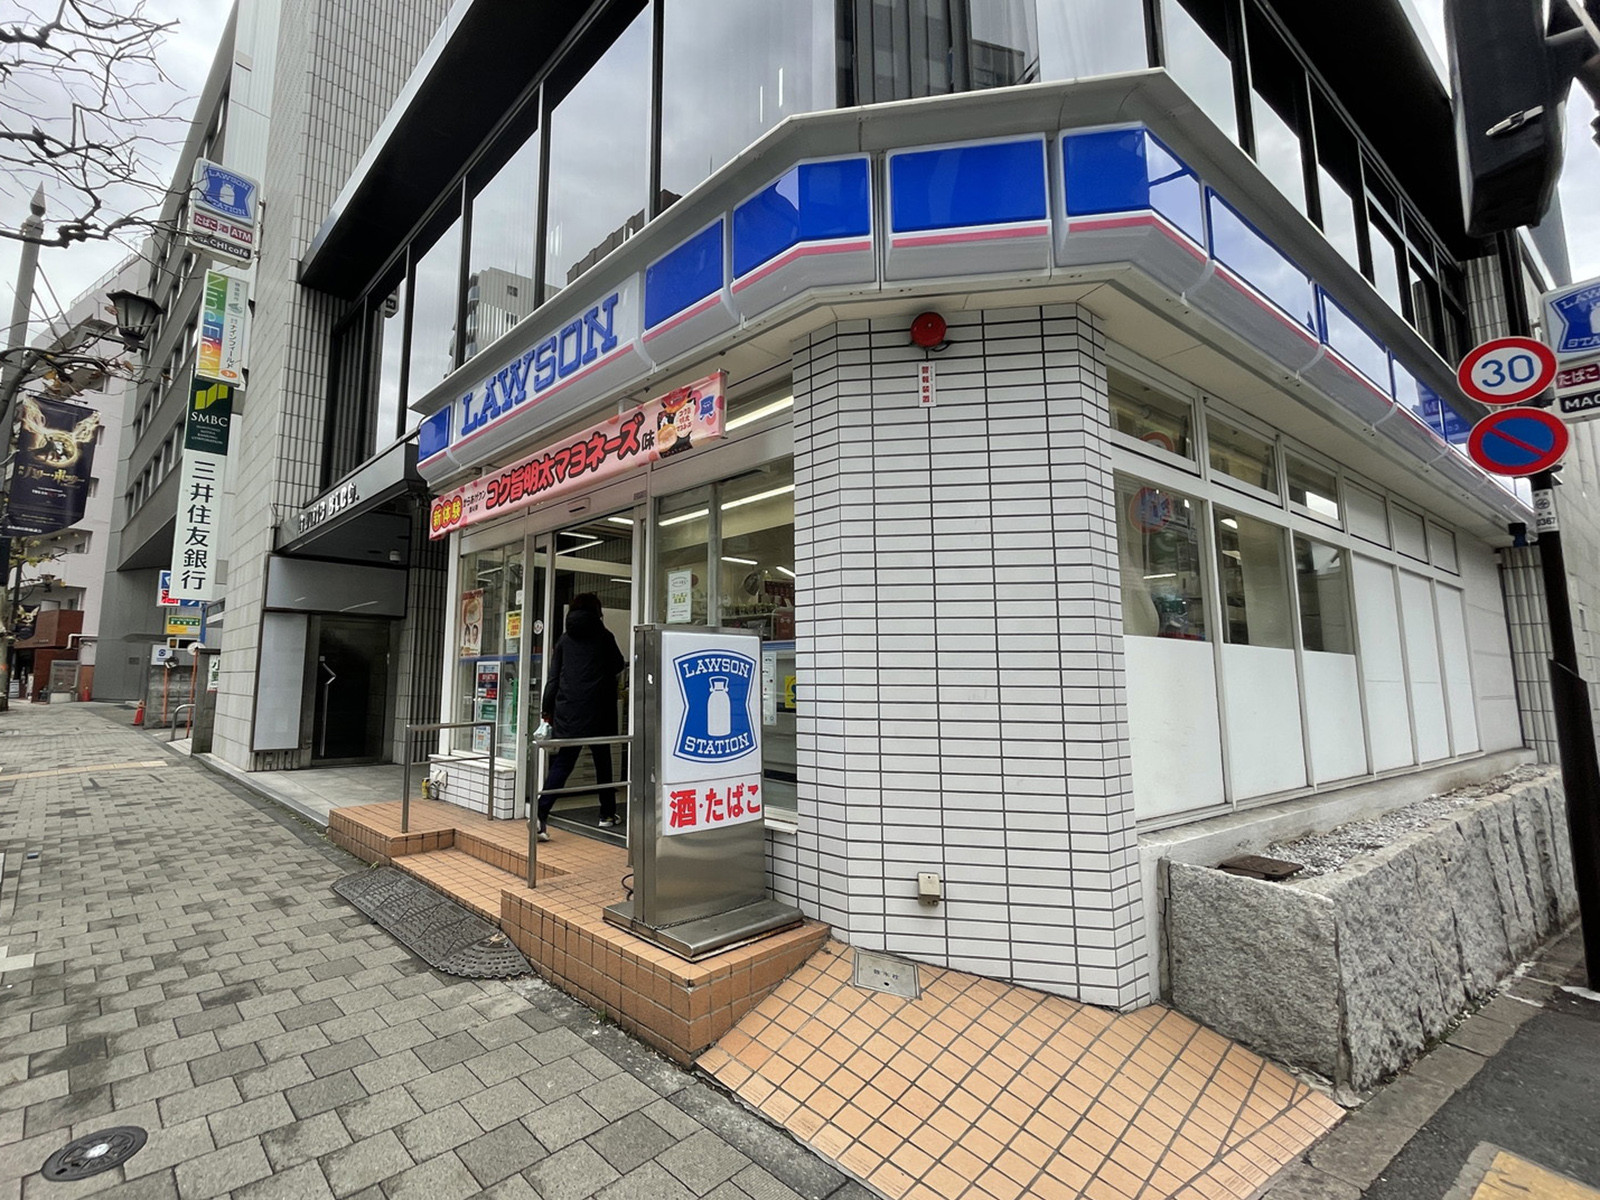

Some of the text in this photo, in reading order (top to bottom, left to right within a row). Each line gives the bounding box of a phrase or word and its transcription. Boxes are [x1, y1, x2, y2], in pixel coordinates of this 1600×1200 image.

[208, 169, 249, 190] LAWSON
[195, 214, 218, 230] たばこ
[231, 229, 252, 243] ATM
[461, 293, 619, 436] LAWSON
[1481, 355, 1534, 387] 30
[1558, 367, 1598, 385] たばこ
[191, 411, 228, 427] SMBC
[181, 460, 216, 590] 三井住友銀行
[682, 658, 750, 678] LAWSON
[684, 733, 750, 755] STATION
[669, 783, 761, 828] 酒・たばこ
